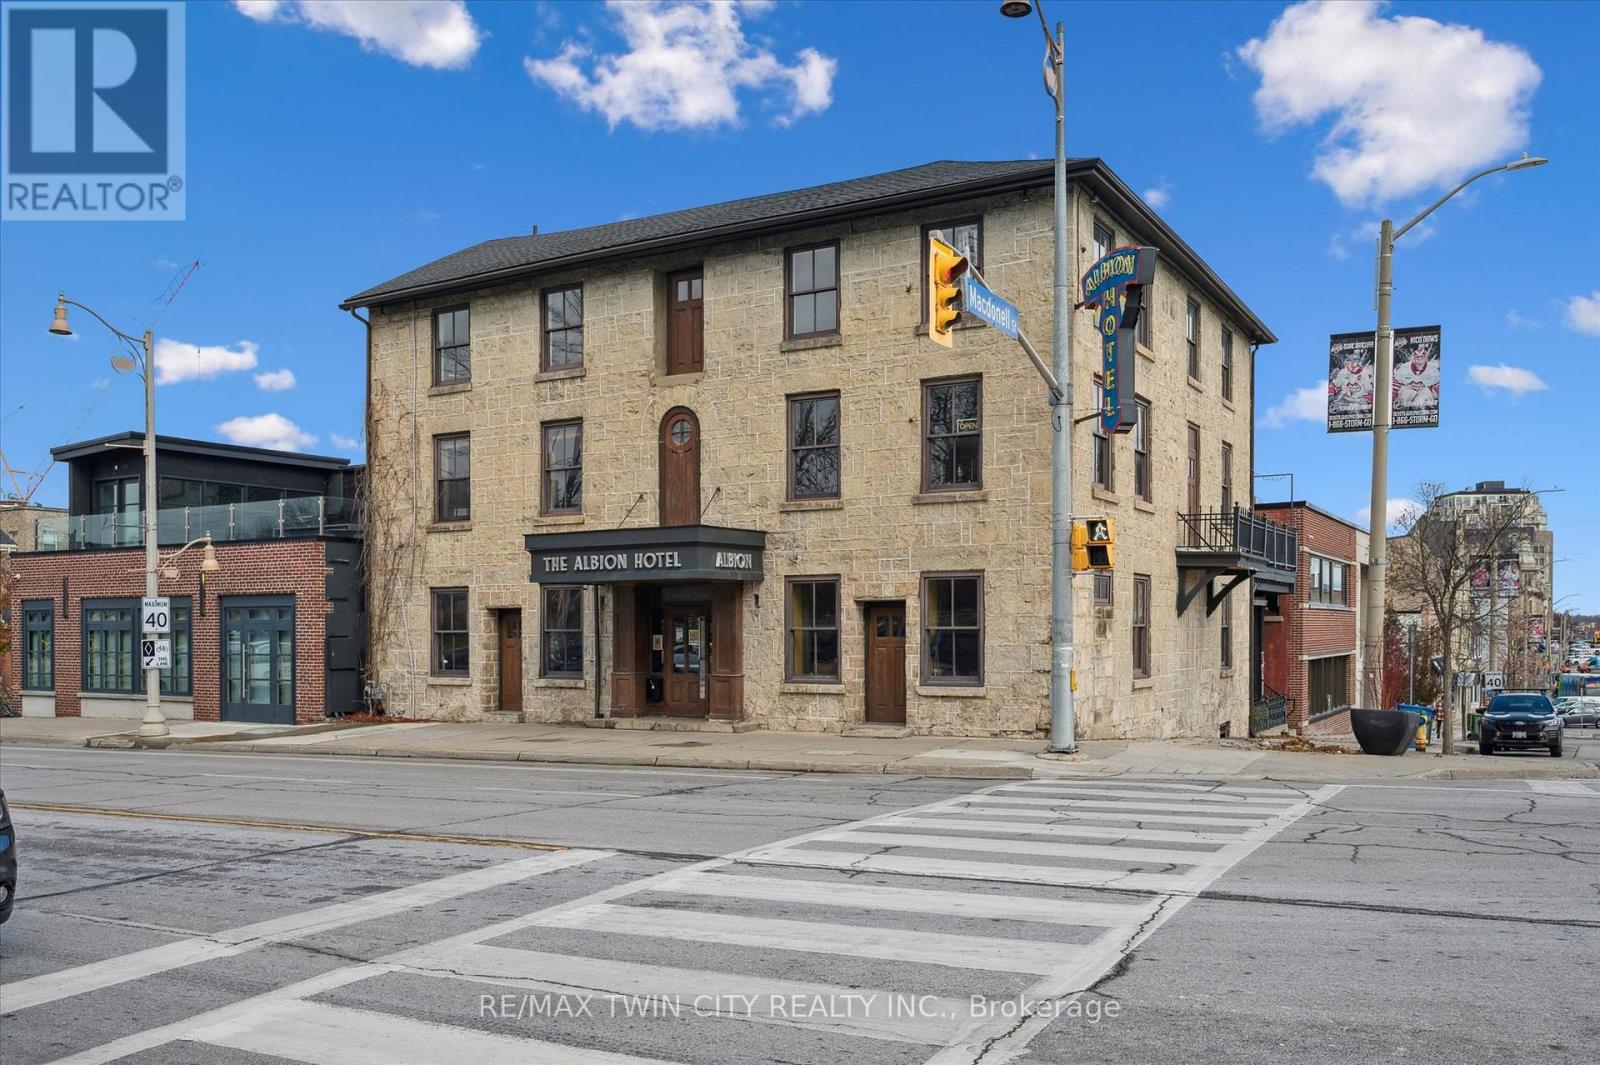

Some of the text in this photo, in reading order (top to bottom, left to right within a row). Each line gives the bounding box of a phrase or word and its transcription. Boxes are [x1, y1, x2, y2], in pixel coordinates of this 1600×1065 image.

[1085, 254, 1135, 296] ALBION
[969, 284, 1010, 330] Macdonell
[1104, 287, 1116, 417] HOTEL
[959, 422, 978, 430] OPEN
[543, 551, 682, 572] THE ALBION HOTEL
[715, 551, 752, 569] ALBION
[145, 612, 167, 628] 40
[1487, 679, 1501, 687] 40
